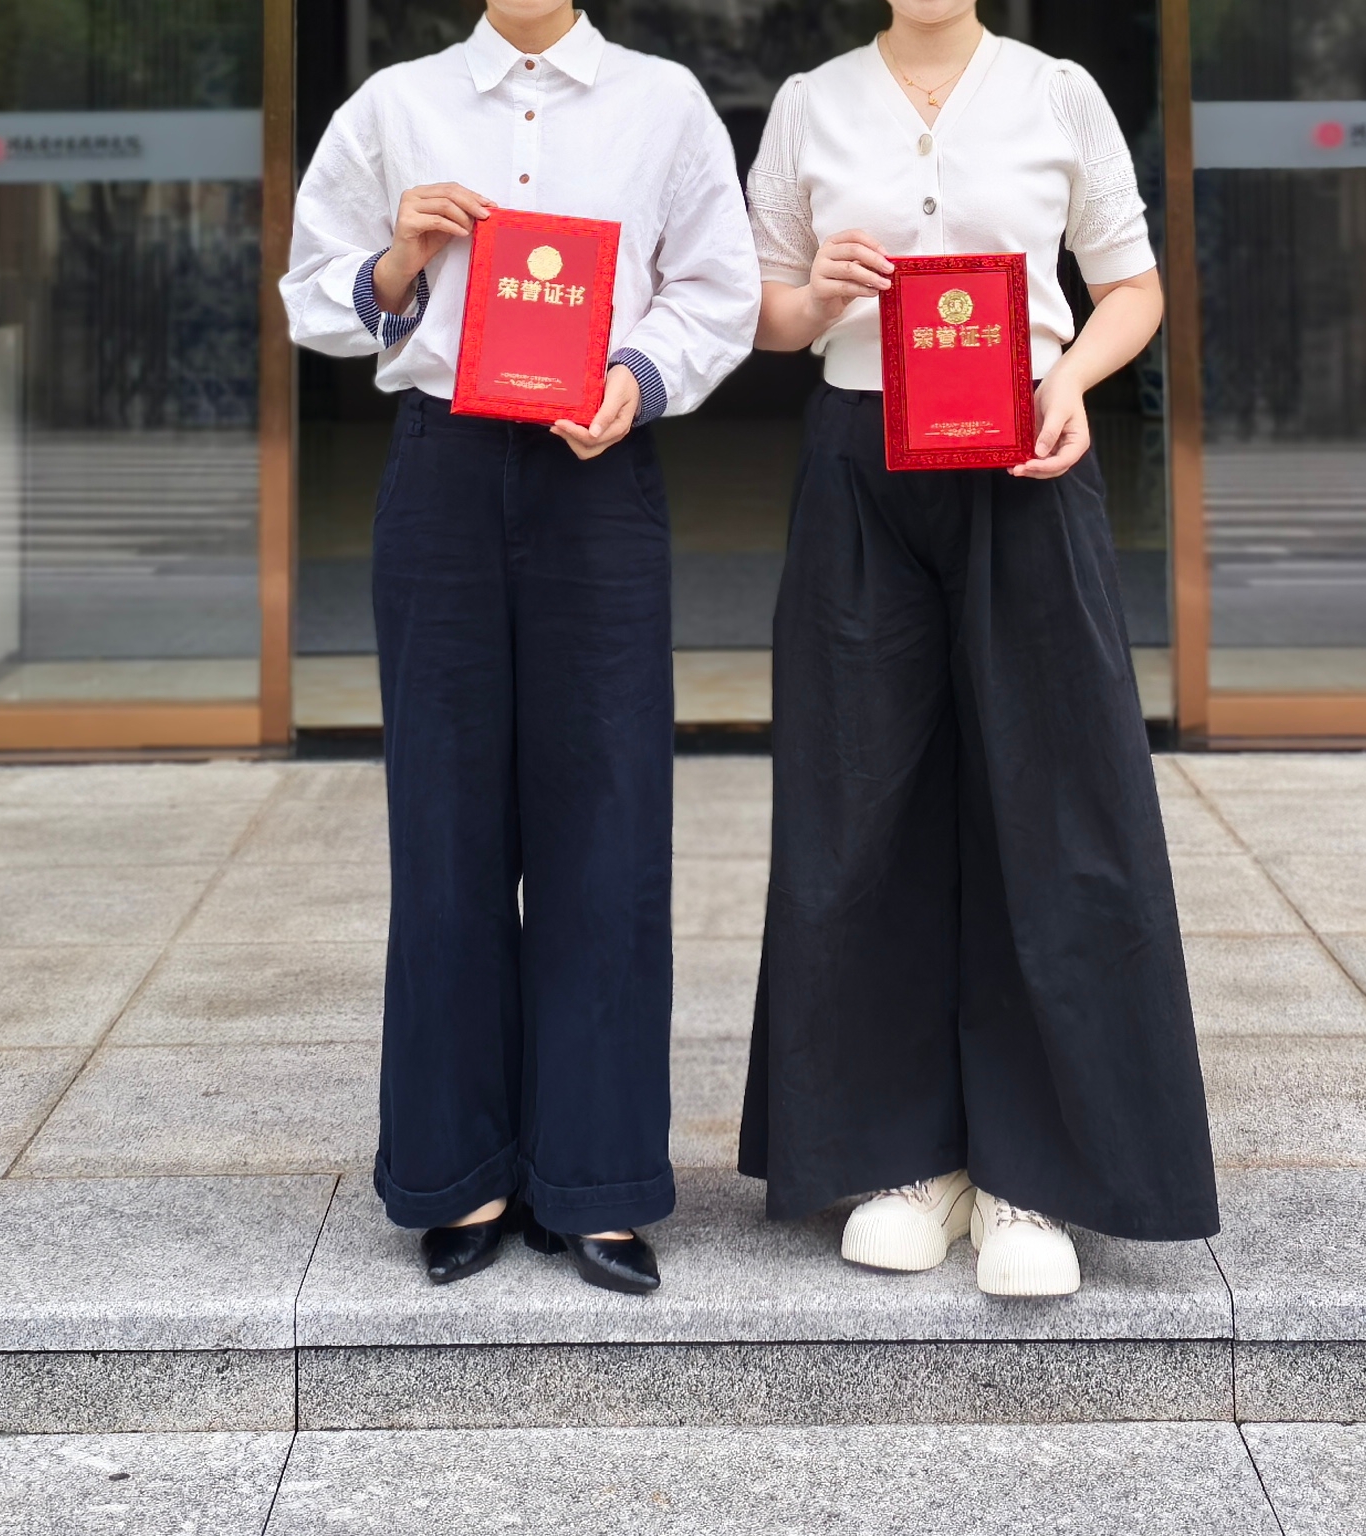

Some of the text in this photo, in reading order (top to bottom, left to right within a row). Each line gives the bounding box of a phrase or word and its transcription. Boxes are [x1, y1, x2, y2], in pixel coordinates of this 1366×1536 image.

[496, 277, 586, 307] 荣誉证书
[912, 324, 1001, 349] 荣誉证书
